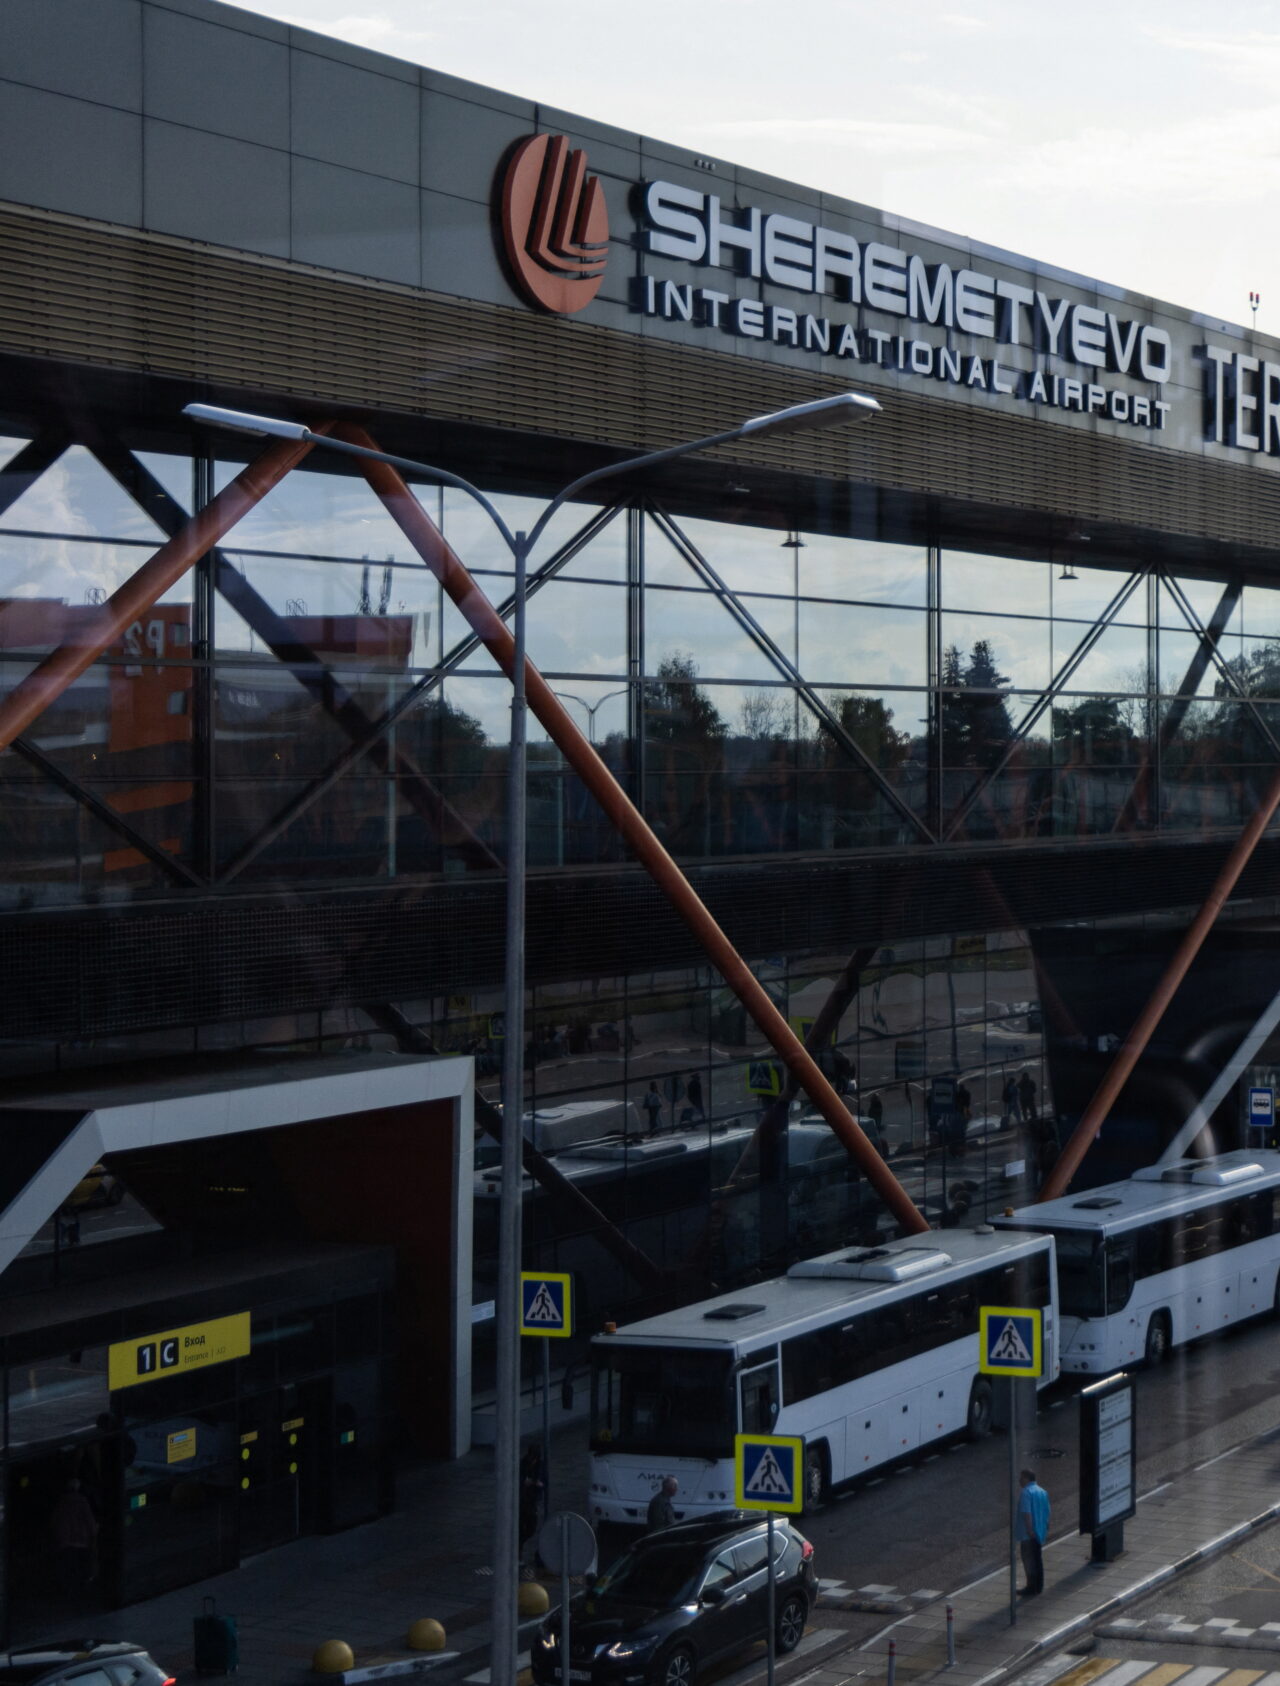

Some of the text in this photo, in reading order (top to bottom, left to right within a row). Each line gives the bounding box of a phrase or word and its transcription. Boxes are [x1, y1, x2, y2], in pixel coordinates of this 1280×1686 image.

[646, 180, 1171, 383] SHEREMETYEVO
[646, 275, 1171, 430] INTERNATIONAL AIRPORT
[142, 1342, 175, 1371] 1 C
[184, 1335, 206, 1348] Вход
